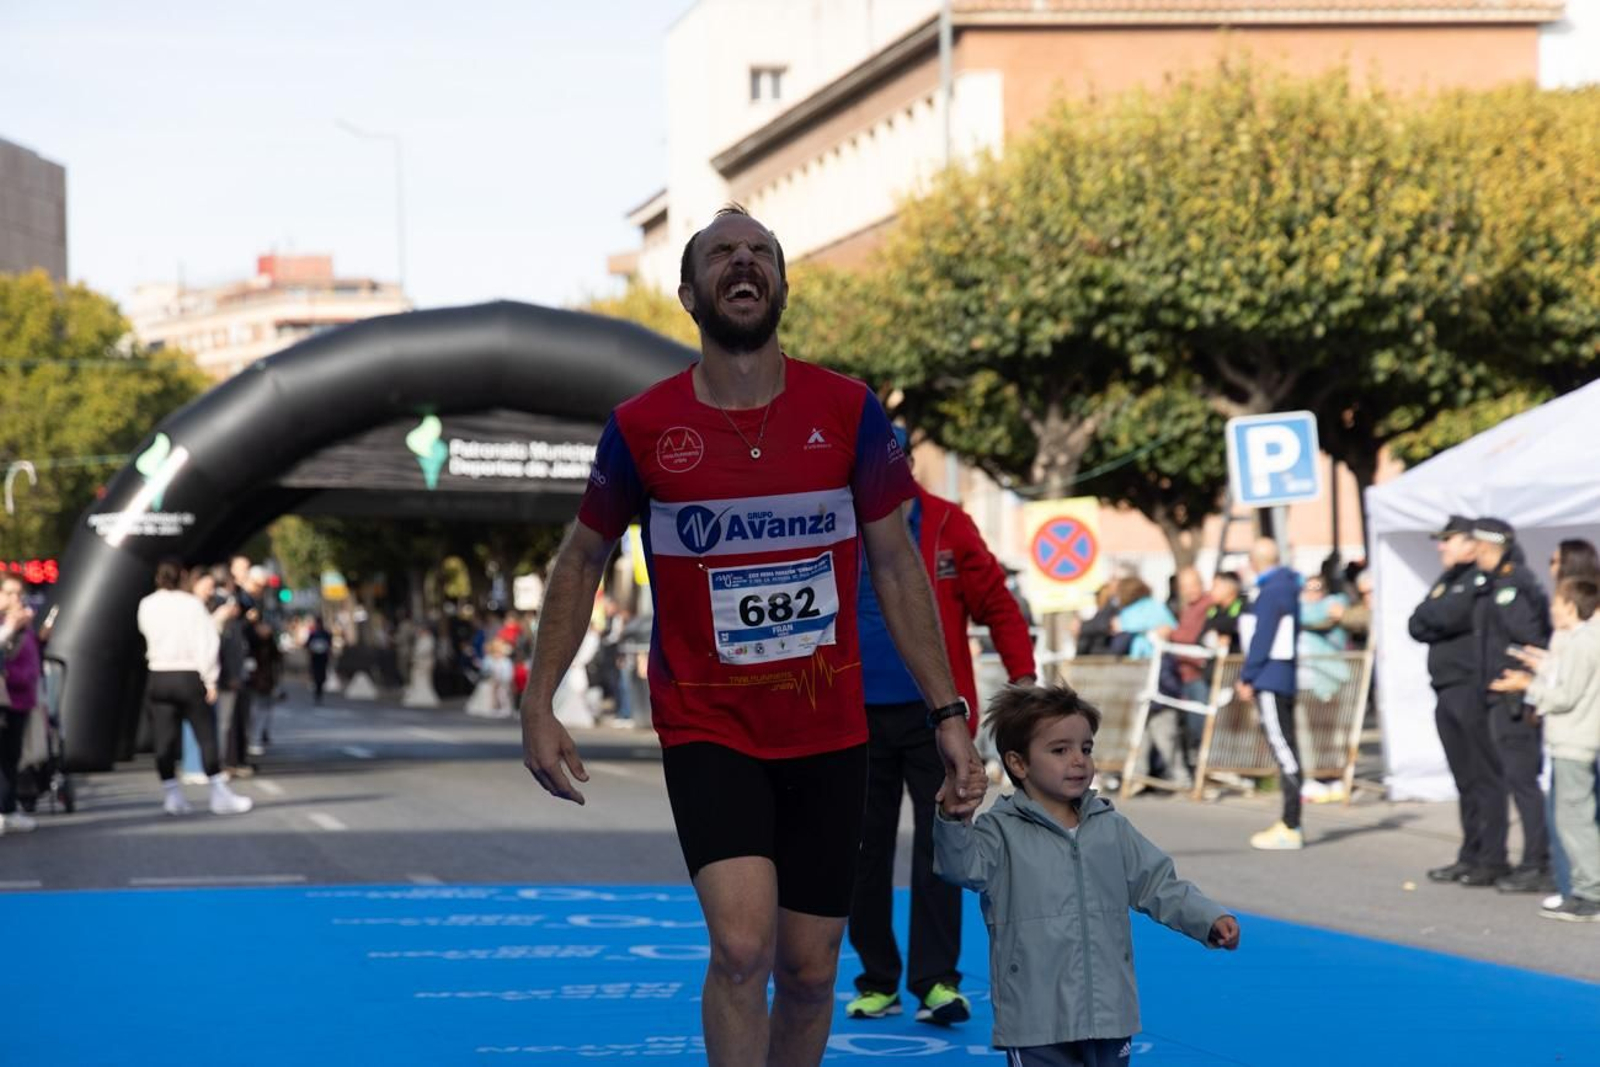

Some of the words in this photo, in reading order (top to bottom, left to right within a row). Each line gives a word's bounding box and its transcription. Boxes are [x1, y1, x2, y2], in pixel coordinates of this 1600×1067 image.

[1245, 424, 1301, 497] P
[725, 511, 836, 541] Avanza
[748, 510, 773, 520] GRUPO
[738, 586, 821, 627] 682
[772, 623, 794, 635] FRAN
